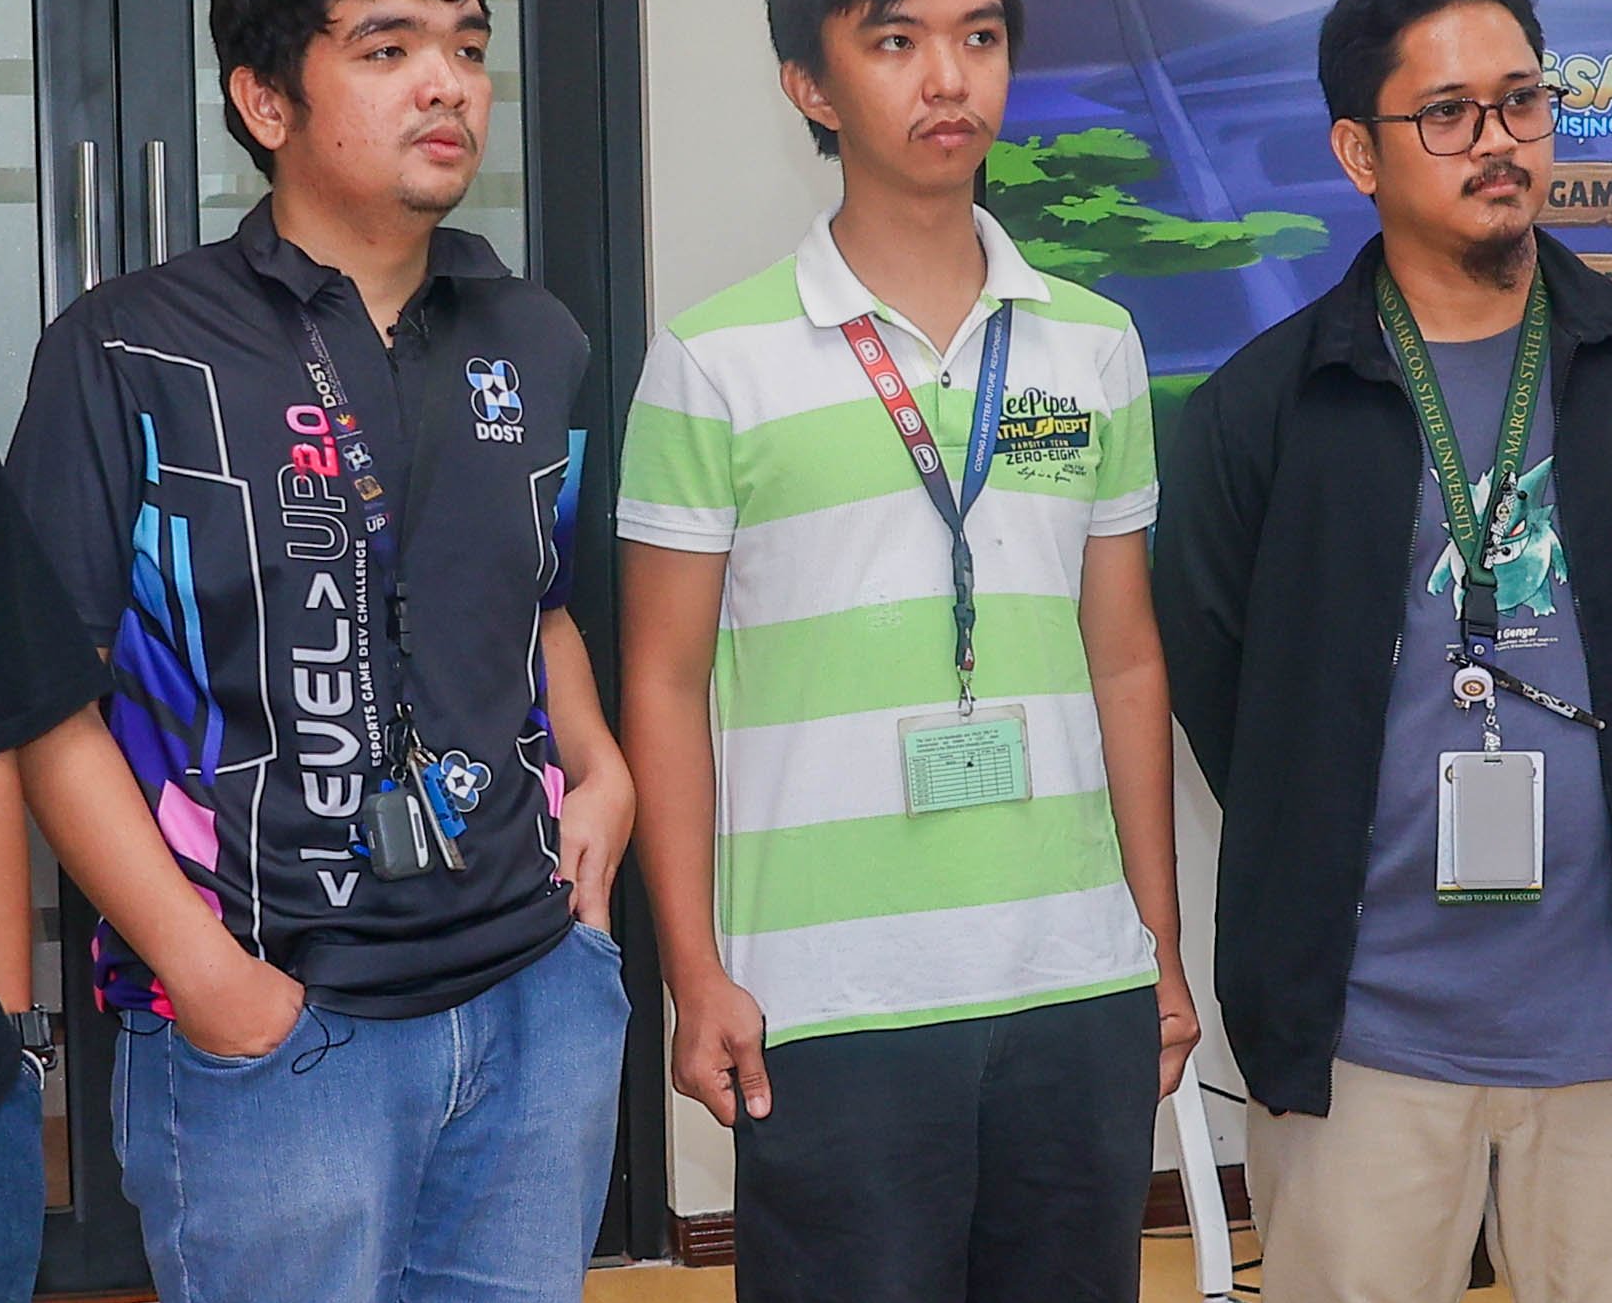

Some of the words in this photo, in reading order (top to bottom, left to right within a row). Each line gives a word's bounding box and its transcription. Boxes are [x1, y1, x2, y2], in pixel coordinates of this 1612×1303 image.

[306, 361, 337, 409] DOST
[1505, 384, 1531, 457] MARCOS
[1519, 329, 1543, 382] STATE
[286, 404, 340, 478] 2.0
[475, 422, 525, 444] DOST
[973, 438, 988, 473] CODING
[981, 400, 993, 430] BETTER
[1011, 440, 1045, 451] VARSITY
[1050, 439, 1069, 448] TEAM
[1055, 417, 1089, 434] DEPT
[1391, 311, 1427, 380] MARCOS
[1417, 382, 1444, 434] STATE
[1435, 436, 1476, 544] UNIVERSITY
[1005, 448, 1082, 466] ZERO-EIGHT
[277, 463, 349, 561] UP
[366, 517, 386, 533] UP
[355, 539, 368, 624] CHALLENGE
[358, 628, 370, 657] DEV
[1503, 627, 1538, 639] Gengar
[358, 660, 375, 702] GAME
[364, 704, 381, 768] ESPORTS
[1438, 893, 1473, 903] HONORED
[1474, 893, 1483, 902] TO
[1510, 892, 1540, 902] SUCCEED
